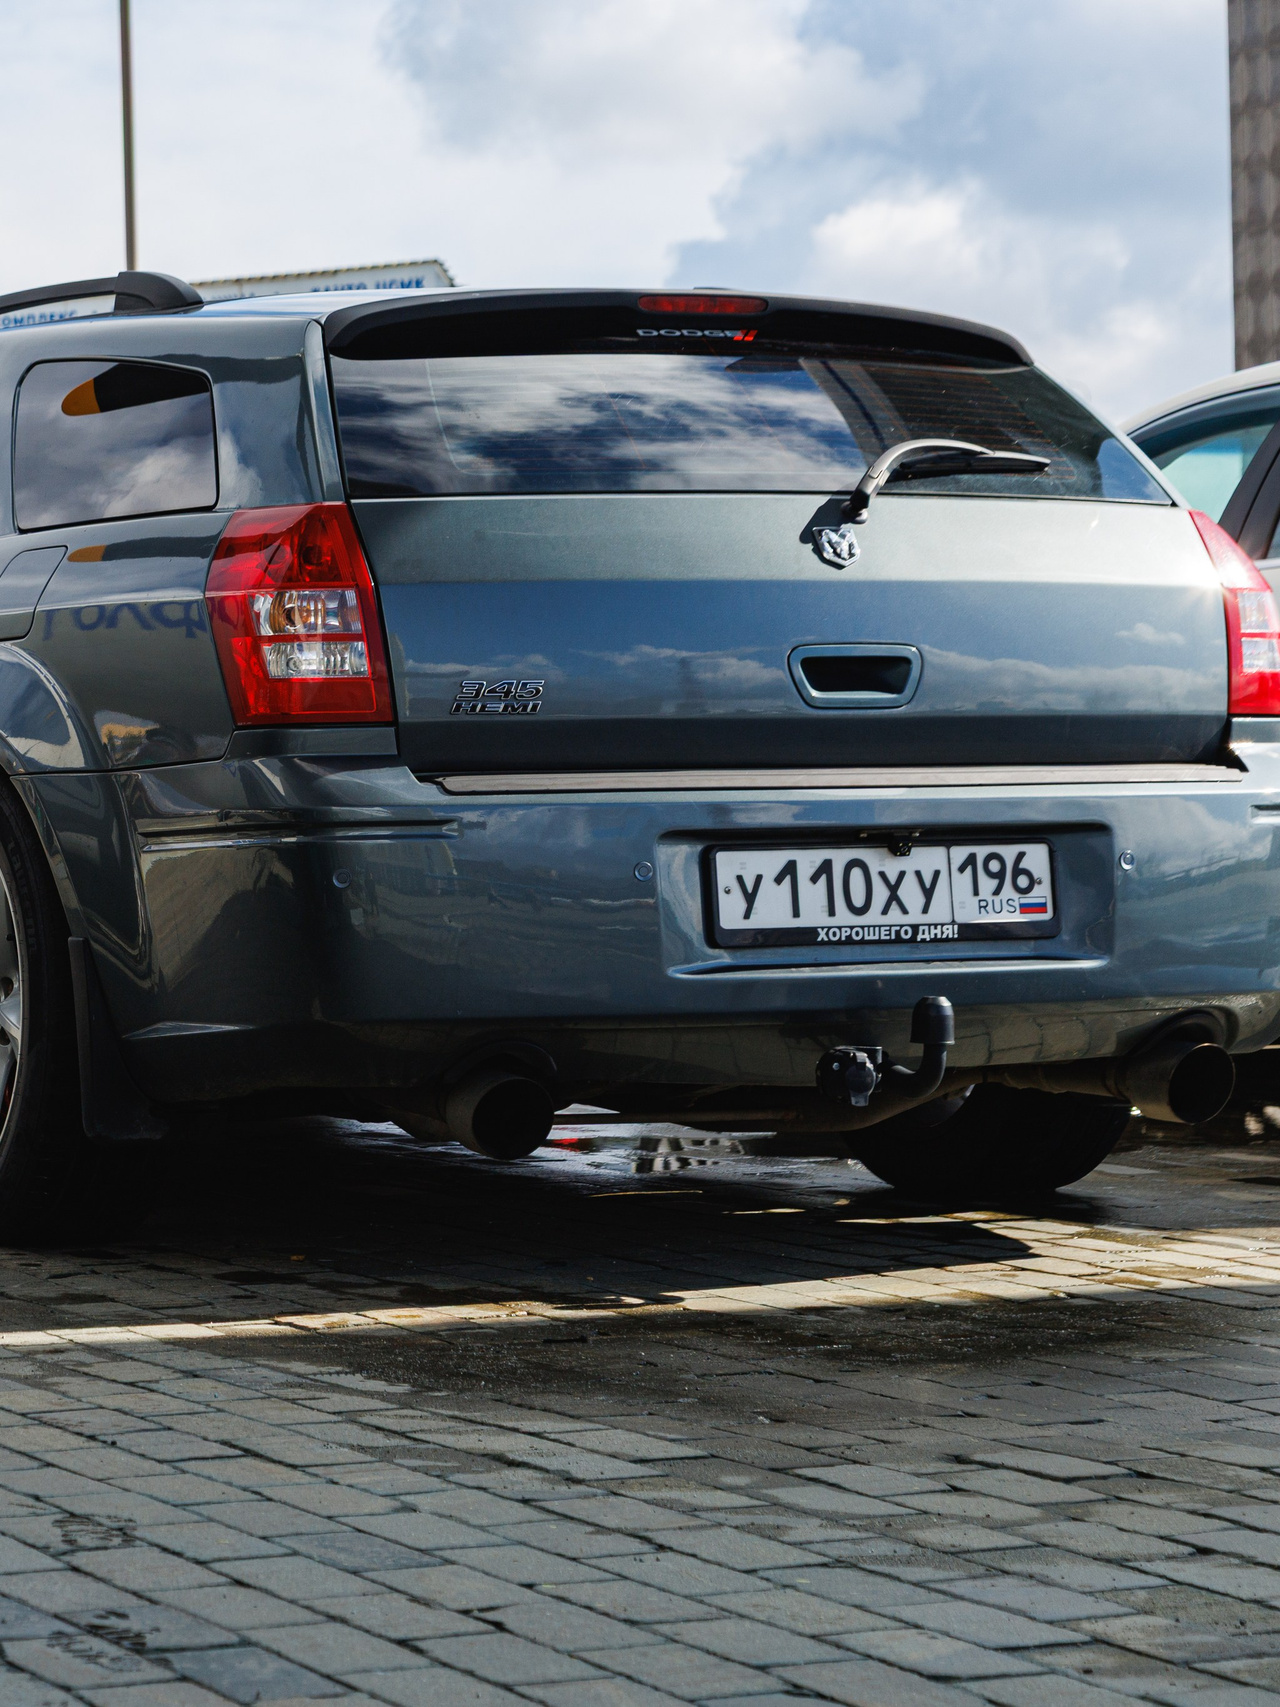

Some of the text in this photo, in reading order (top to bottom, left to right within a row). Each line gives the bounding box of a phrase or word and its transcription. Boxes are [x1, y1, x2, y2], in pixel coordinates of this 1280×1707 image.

[636, 328, 744, 338] DODGE
[455, 680, 545, 700] 345
[450, 700, 542, 715] HEMI
[957, 851, 1036, 897] 196
[735, 858, 942, 920] У110ХУ
[977, 899, 1017, 915] RUS
[816, 924, 959, 942] ХОРОШЕГО ДНЯ!
